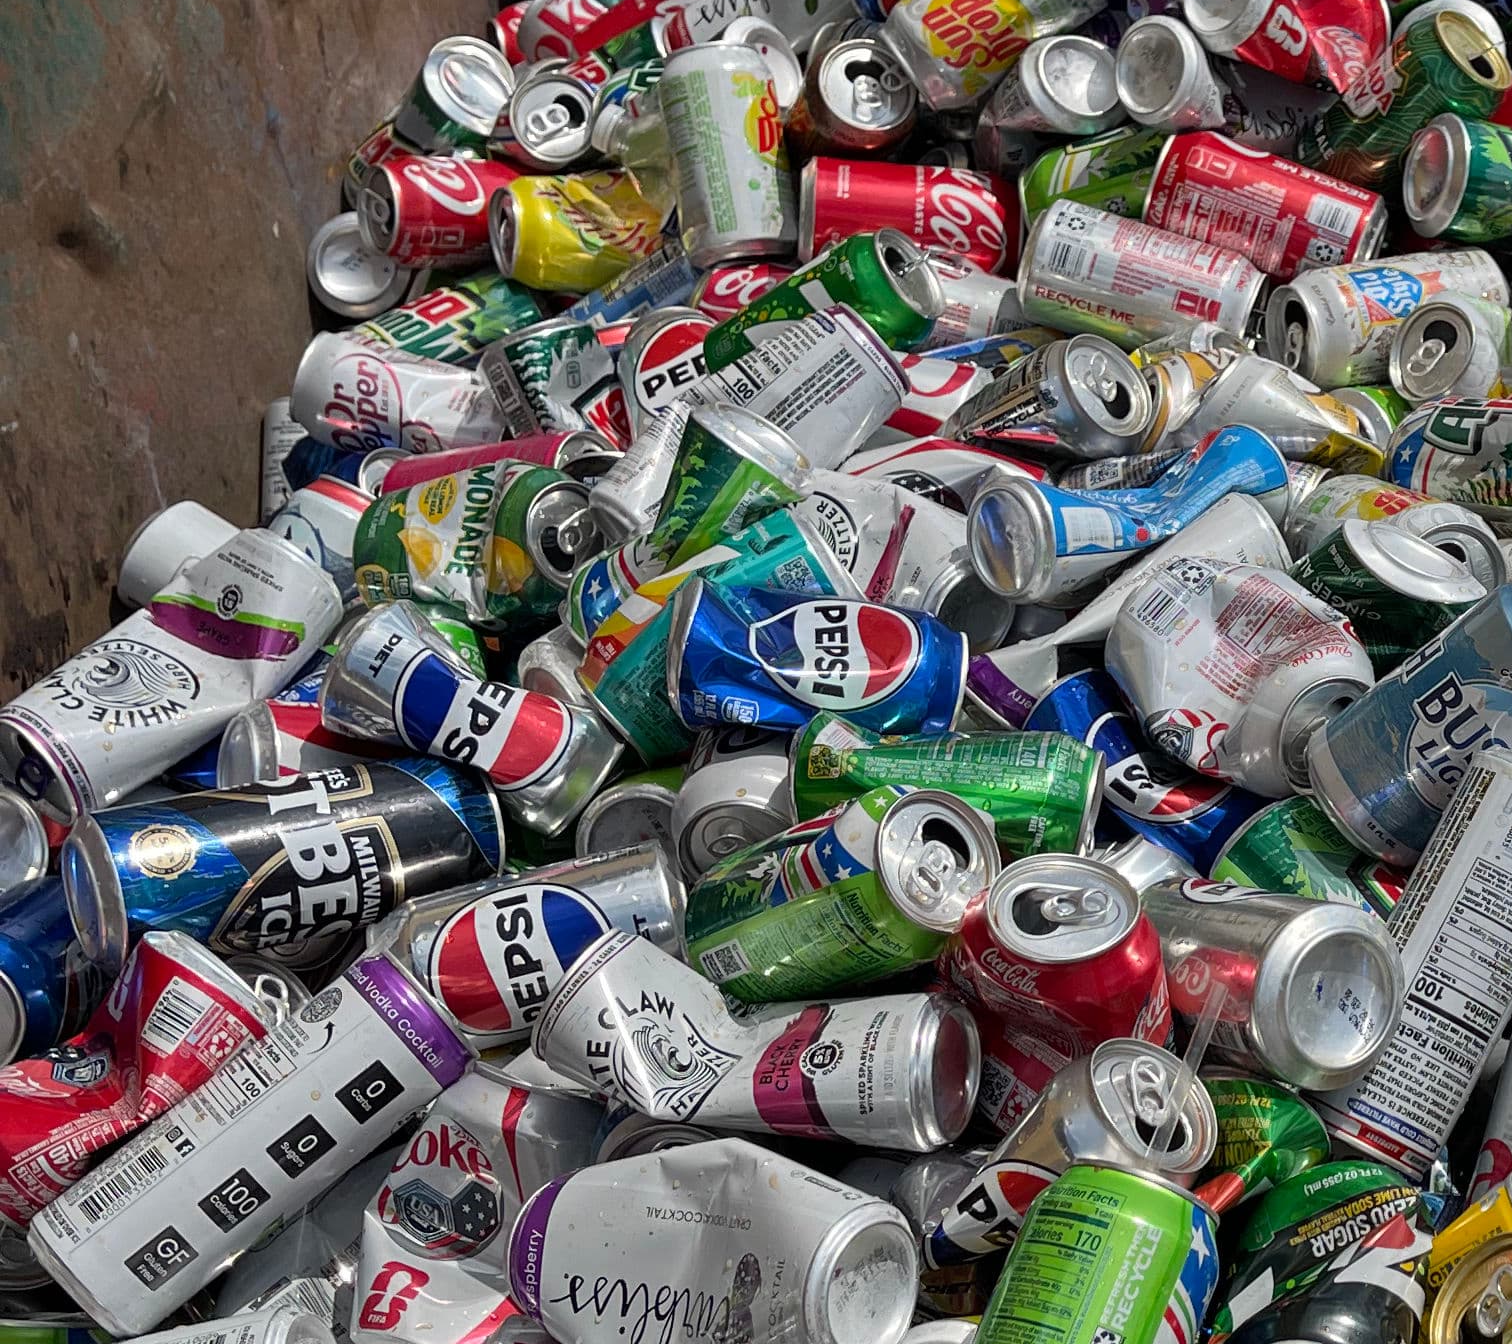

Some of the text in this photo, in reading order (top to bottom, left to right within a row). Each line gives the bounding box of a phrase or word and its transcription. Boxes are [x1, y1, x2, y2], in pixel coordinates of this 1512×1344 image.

[921, 3, 979, 69] Sun
[1034, 285, 1135, 326] RECYCLE ME
[733, 376, 753, 400] 100
[366, 632, 406, 679] DIET
[812, 603, 850, 697] PEPSI
[88, 699, 188, 730] WHITE
[258, 891, 293, 950] ICE
[847, 892, 880, 935] Nutrition
[980, 947, 1041, 994] Coca-Cola
[1414, 976, 1445, 1003] 100
[365, 981, 445, 1069] Vodka Cocktail
[366, 1077, 388, 1100] 0
[220, 1176, 261, 1219] 100
[1087, 1191, 1120, 1209] Facts
[154, 1236, 187, 1268] GF
[1075, 1226, 1102, 1251] 170
[1310, 1222, 1359, 1258] SUGAR
[1114, 1226, 1163, 1332] RECYCLE
[366, 1311, 388, 1325] FIFA
